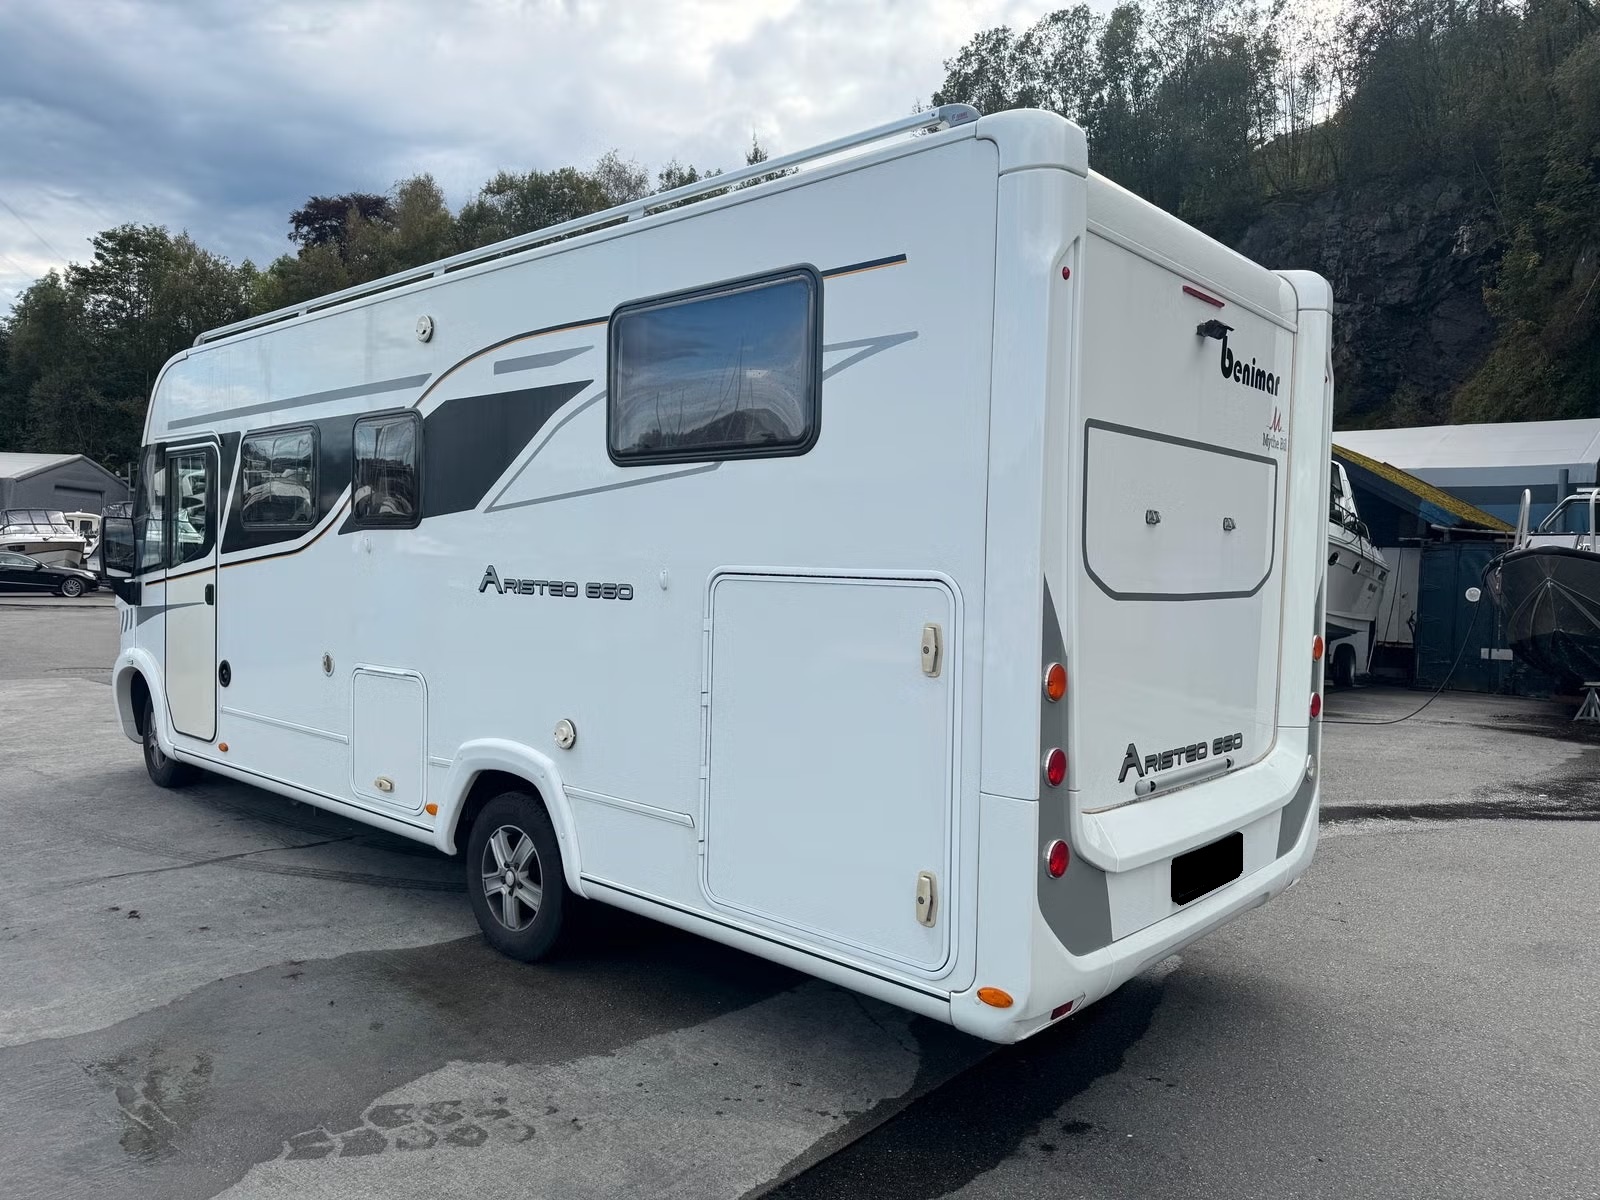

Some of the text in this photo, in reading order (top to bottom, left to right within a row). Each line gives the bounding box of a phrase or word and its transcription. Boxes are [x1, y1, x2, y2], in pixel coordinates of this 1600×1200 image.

[1221, 335, 1280, 396] benimar
[478, 565, 633, 600] ARISTEO 660
[1118, 733, 1243, 783] ARISTEO 660
